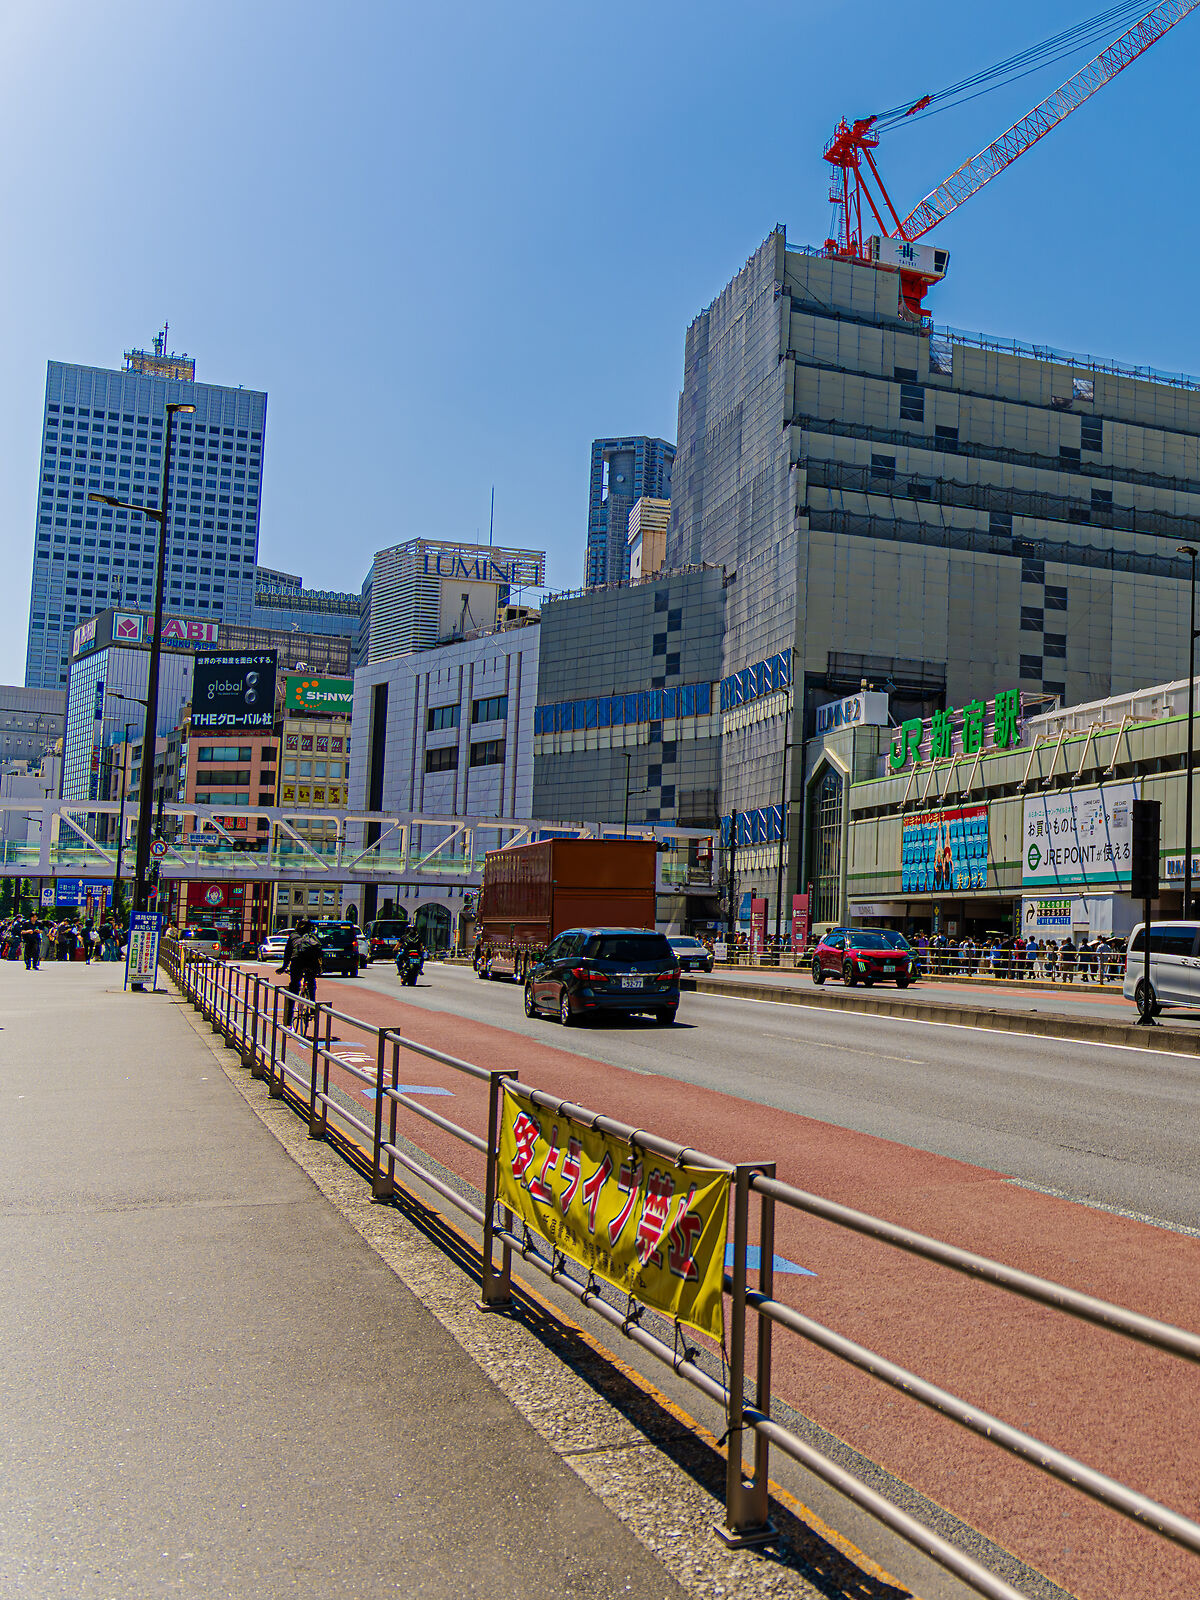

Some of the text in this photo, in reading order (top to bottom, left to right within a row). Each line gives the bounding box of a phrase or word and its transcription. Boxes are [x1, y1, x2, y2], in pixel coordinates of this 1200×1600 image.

[423, 554, 523, 583] LUMINE
[207, 679, 243, 699] global
[192, 712, 273, 725] THEグローバル社
[889, 688, 1021, 769] JR新宿駅
[1028, 817, 1077, 838] お買いものに
[1043, 848, 1062, 866] JRE
